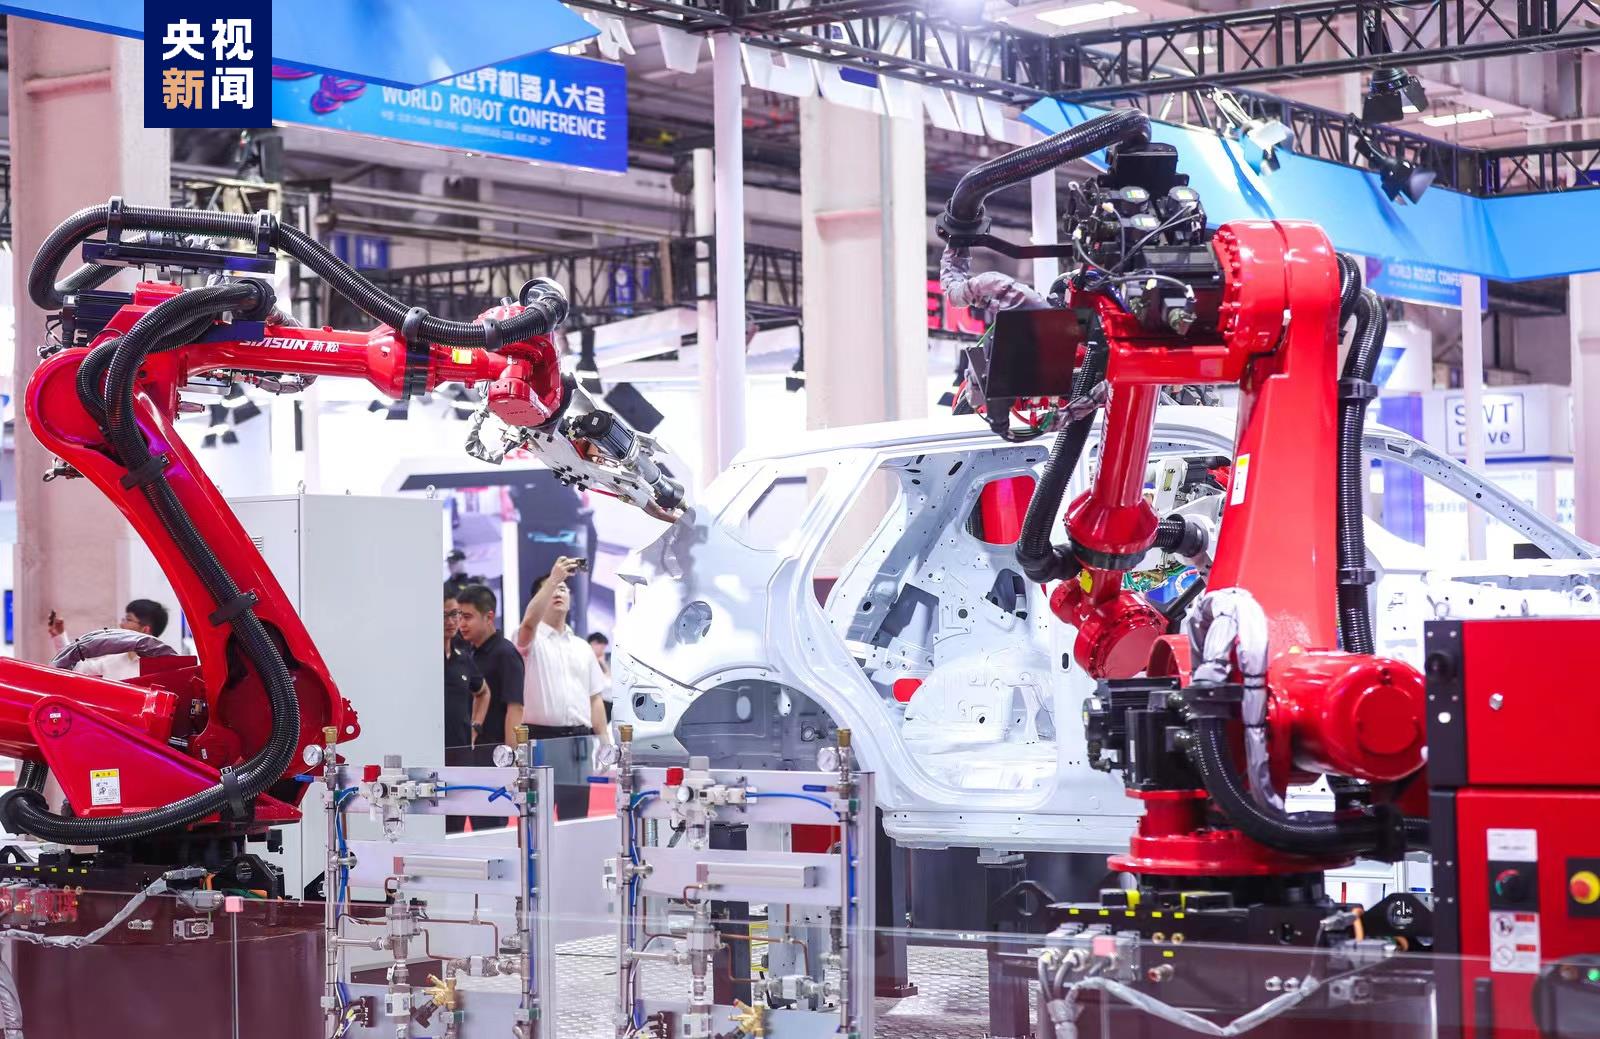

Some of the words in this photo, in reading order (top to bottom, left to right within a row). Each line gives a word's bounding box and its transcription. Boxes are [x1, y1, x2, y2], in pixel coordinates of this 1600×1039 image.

[383, 85, 443, 112] WORLD
[450, 93, 505, 123] ROBOT
[509, 105, 607, 140] CONFERENCE
[438, 67, 605, 115] 世界机器人大会
